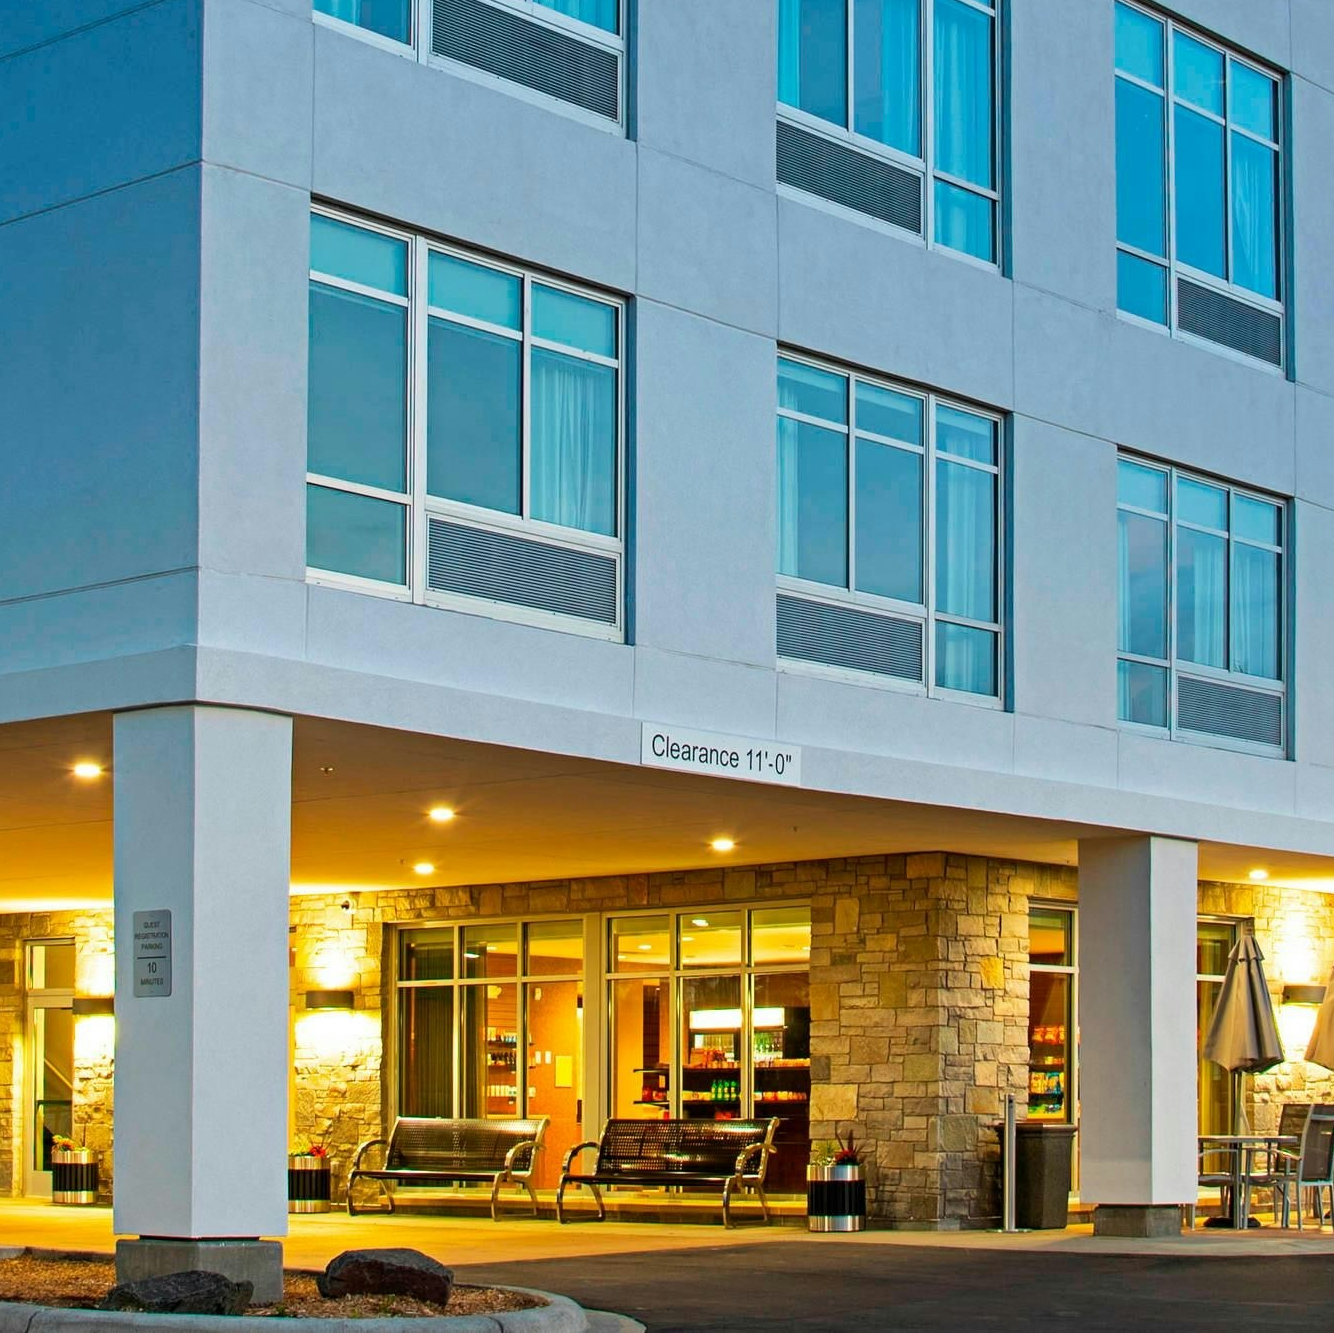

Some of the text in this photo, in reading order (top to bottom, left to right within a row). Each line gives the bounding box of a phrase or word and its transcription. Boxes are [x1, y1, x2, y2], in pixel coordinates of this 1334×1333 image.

[651, 733, 792, 775] Clearance 11'-0"
[147, 961, 157, 974] 10
